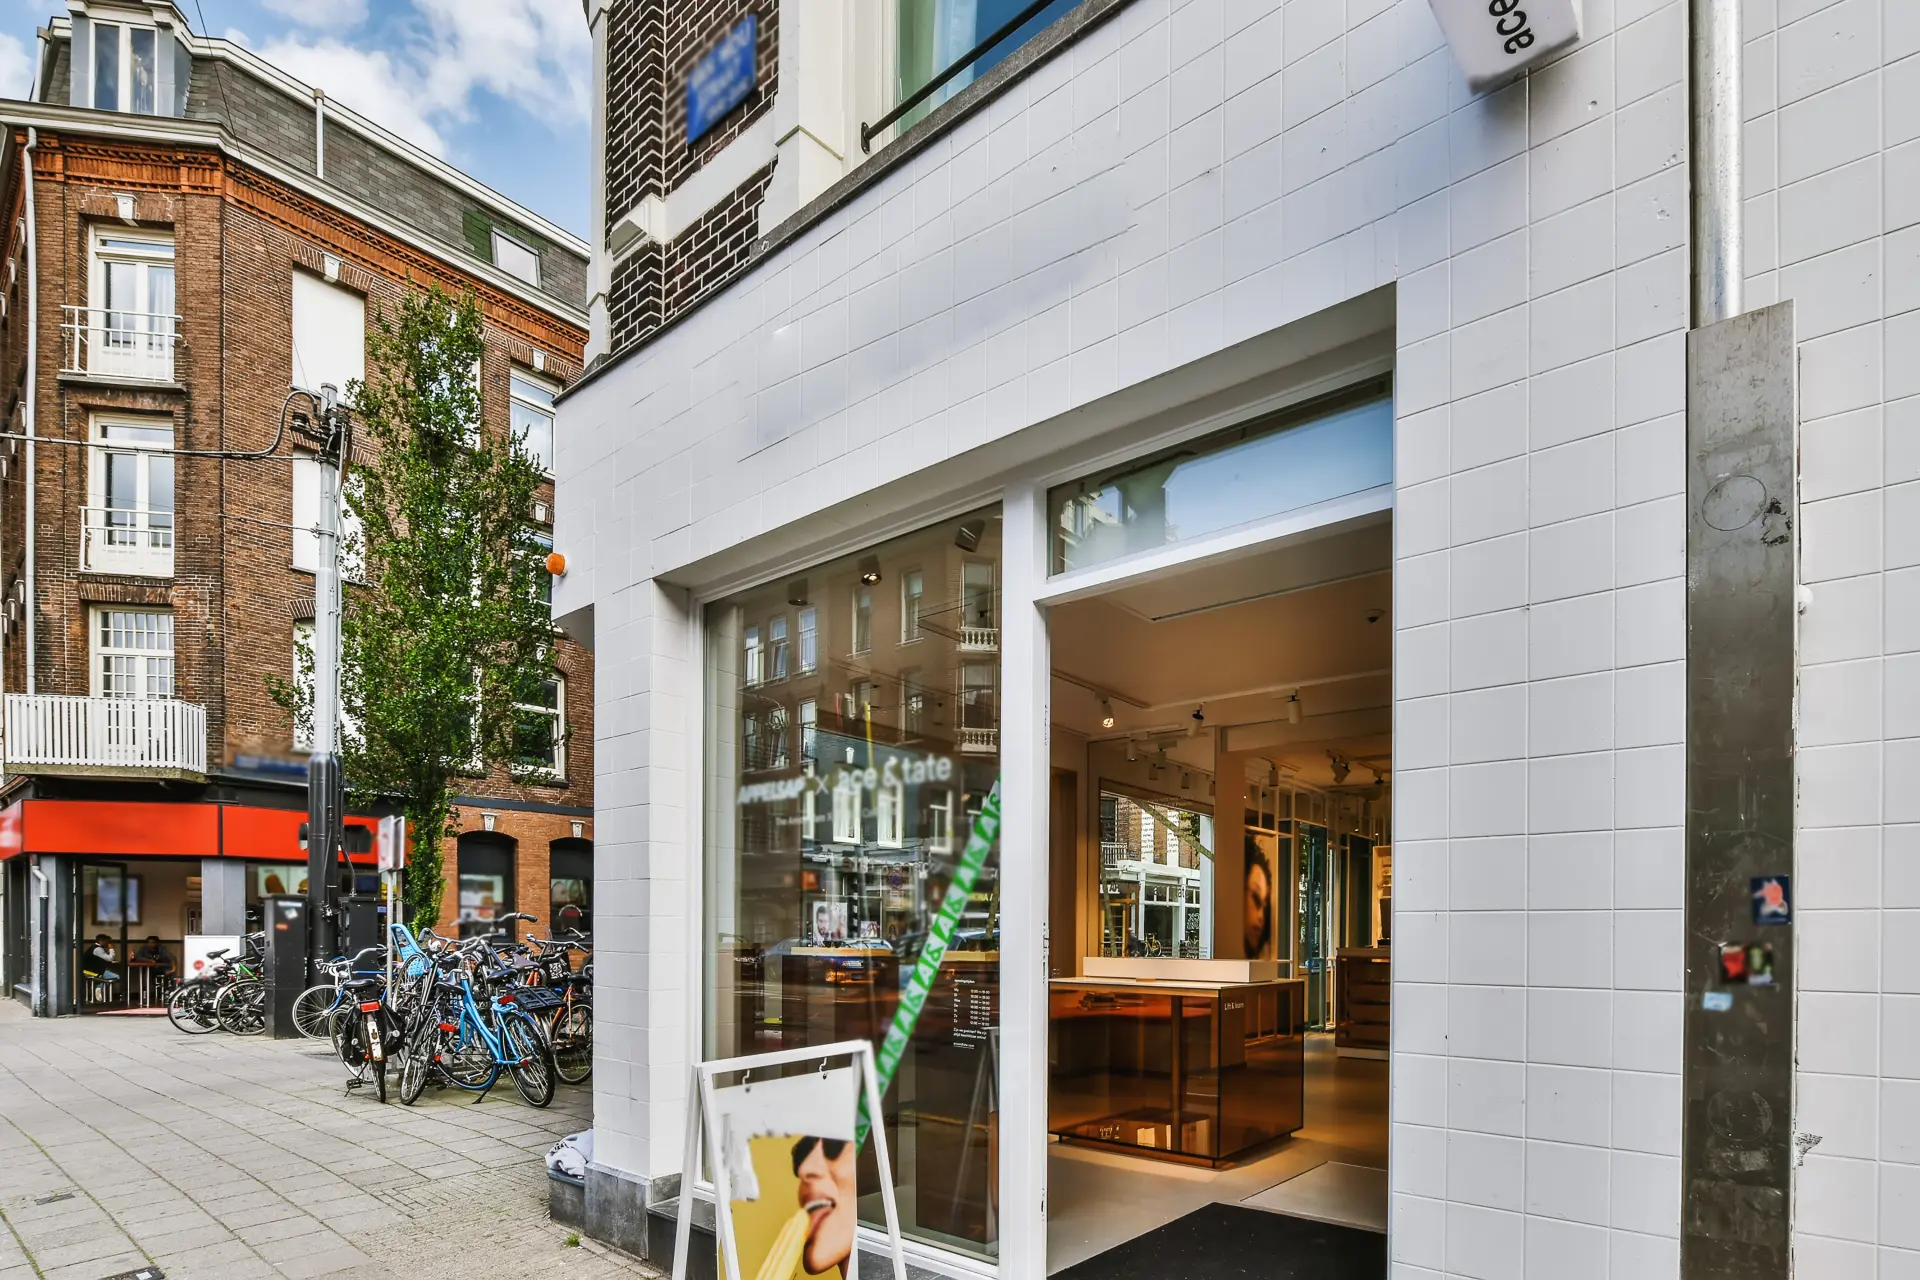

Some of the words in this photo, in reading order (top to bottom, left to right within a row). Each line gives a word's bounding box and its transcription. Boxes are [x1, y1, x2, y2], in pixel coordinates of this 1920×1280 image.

[1488, 0, 1535, 55] ace
[838, 767, 877, 792] ace
[882, 756, 898, 788] &
[902, 753, 952, 784] tate
